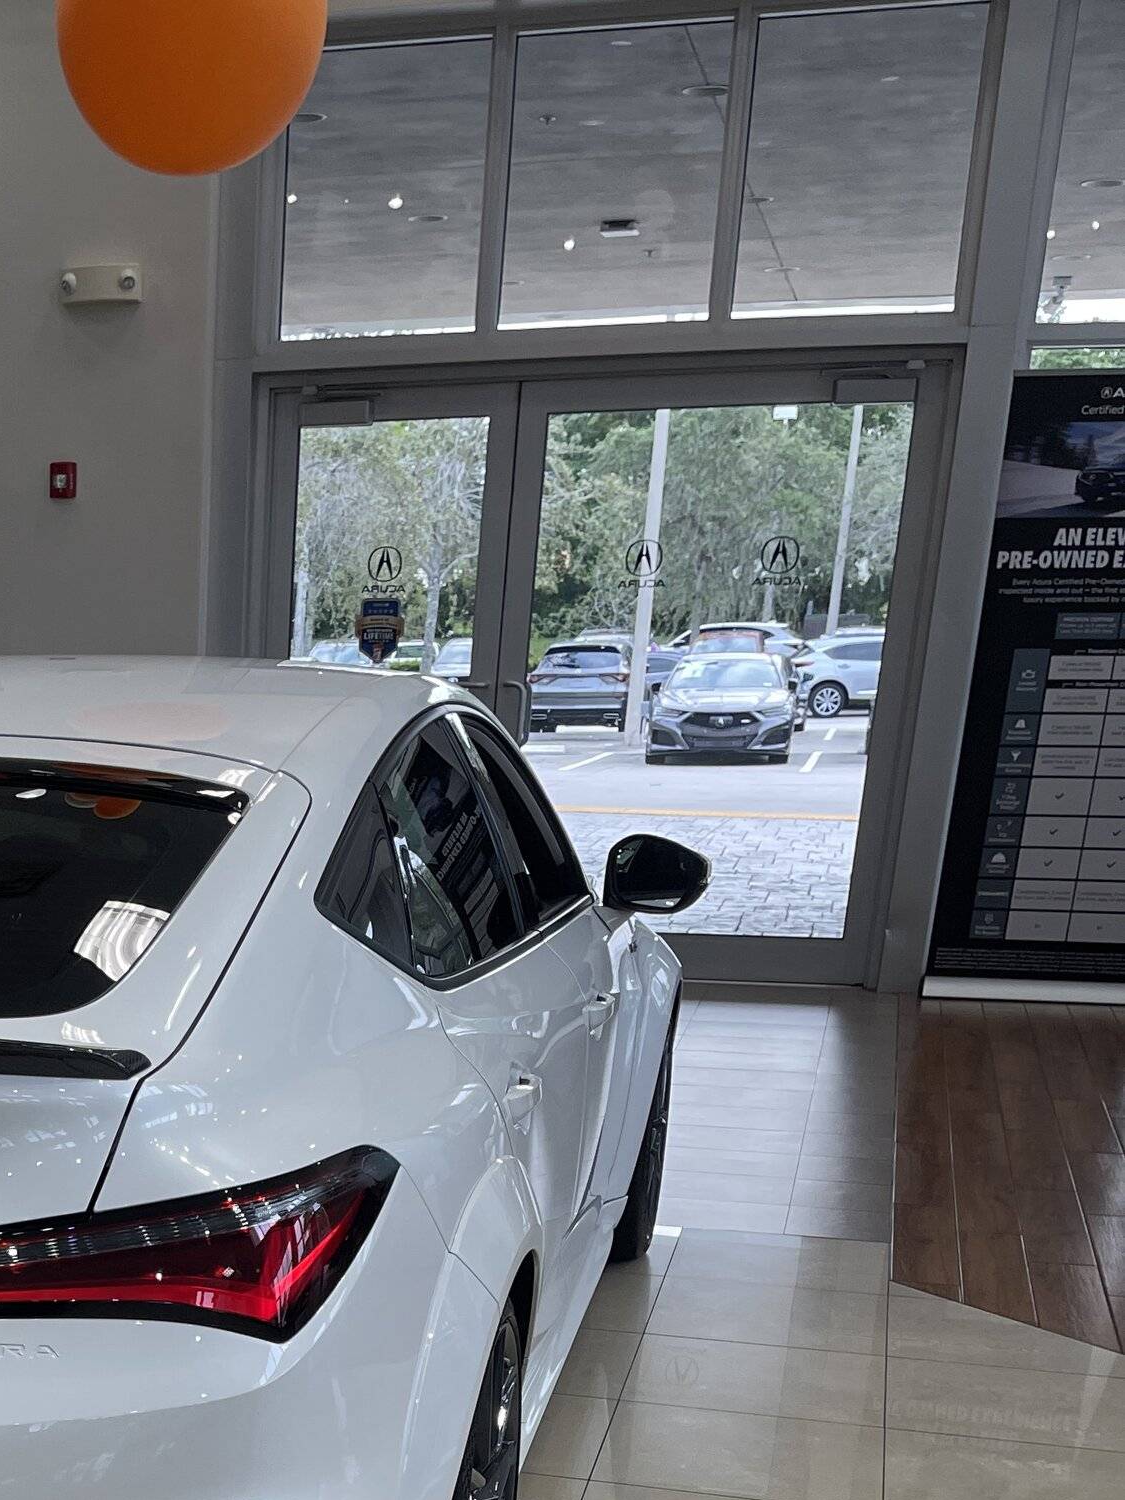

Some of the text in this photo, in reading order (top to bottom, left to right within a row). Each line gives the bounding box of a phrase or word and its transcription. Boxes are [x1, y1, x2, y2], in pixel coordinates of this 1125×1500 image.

[1081, 404, 1125, 416] Certified
[1052, 527, 1083, 547] AN
[996, 550, 1110, 570] PRE-OWNED
